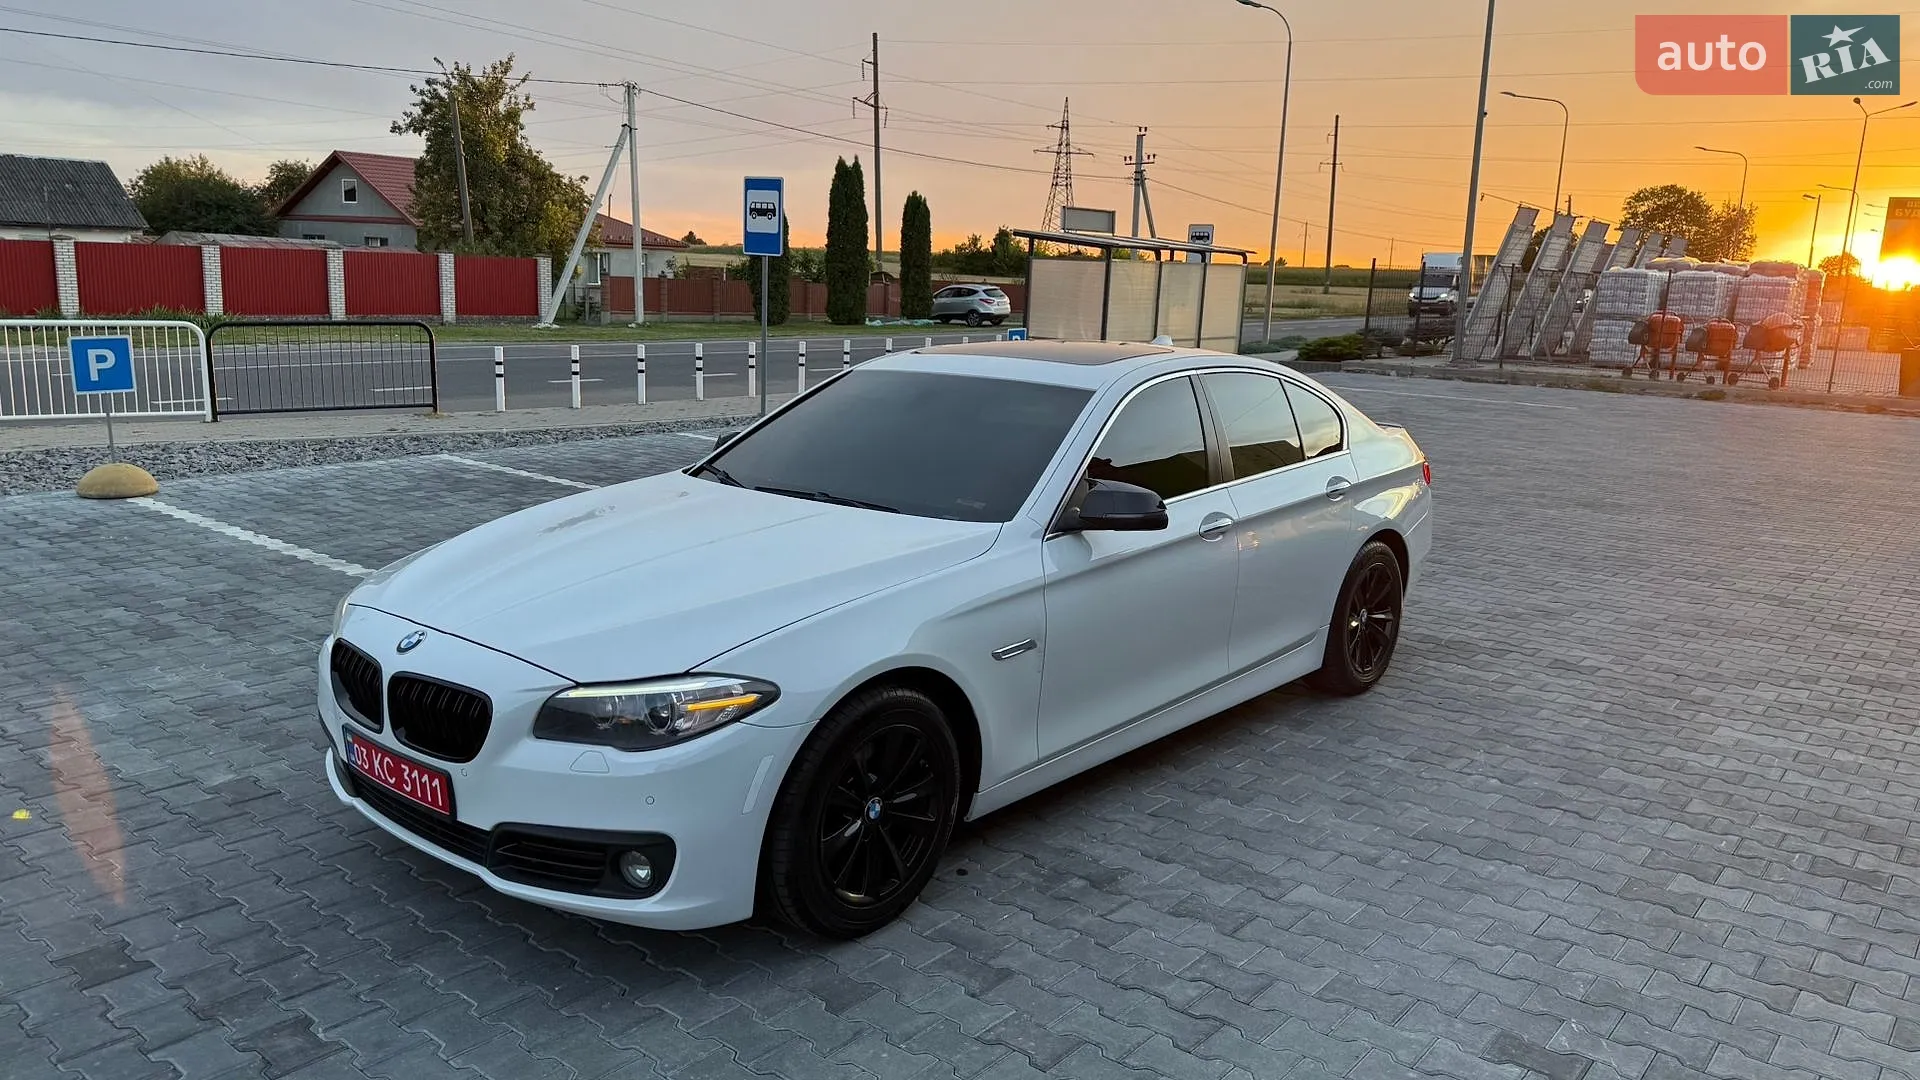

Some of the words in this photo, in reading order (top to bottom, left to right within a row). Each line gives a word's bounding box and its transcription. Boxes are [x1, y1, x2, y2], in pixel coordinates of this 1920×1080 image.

[87, 348, 116, 382] P
[353, 743, 369, 770] 03
[372, 749, 396, 784] KC
[400, 763, 442, 807] 3111
